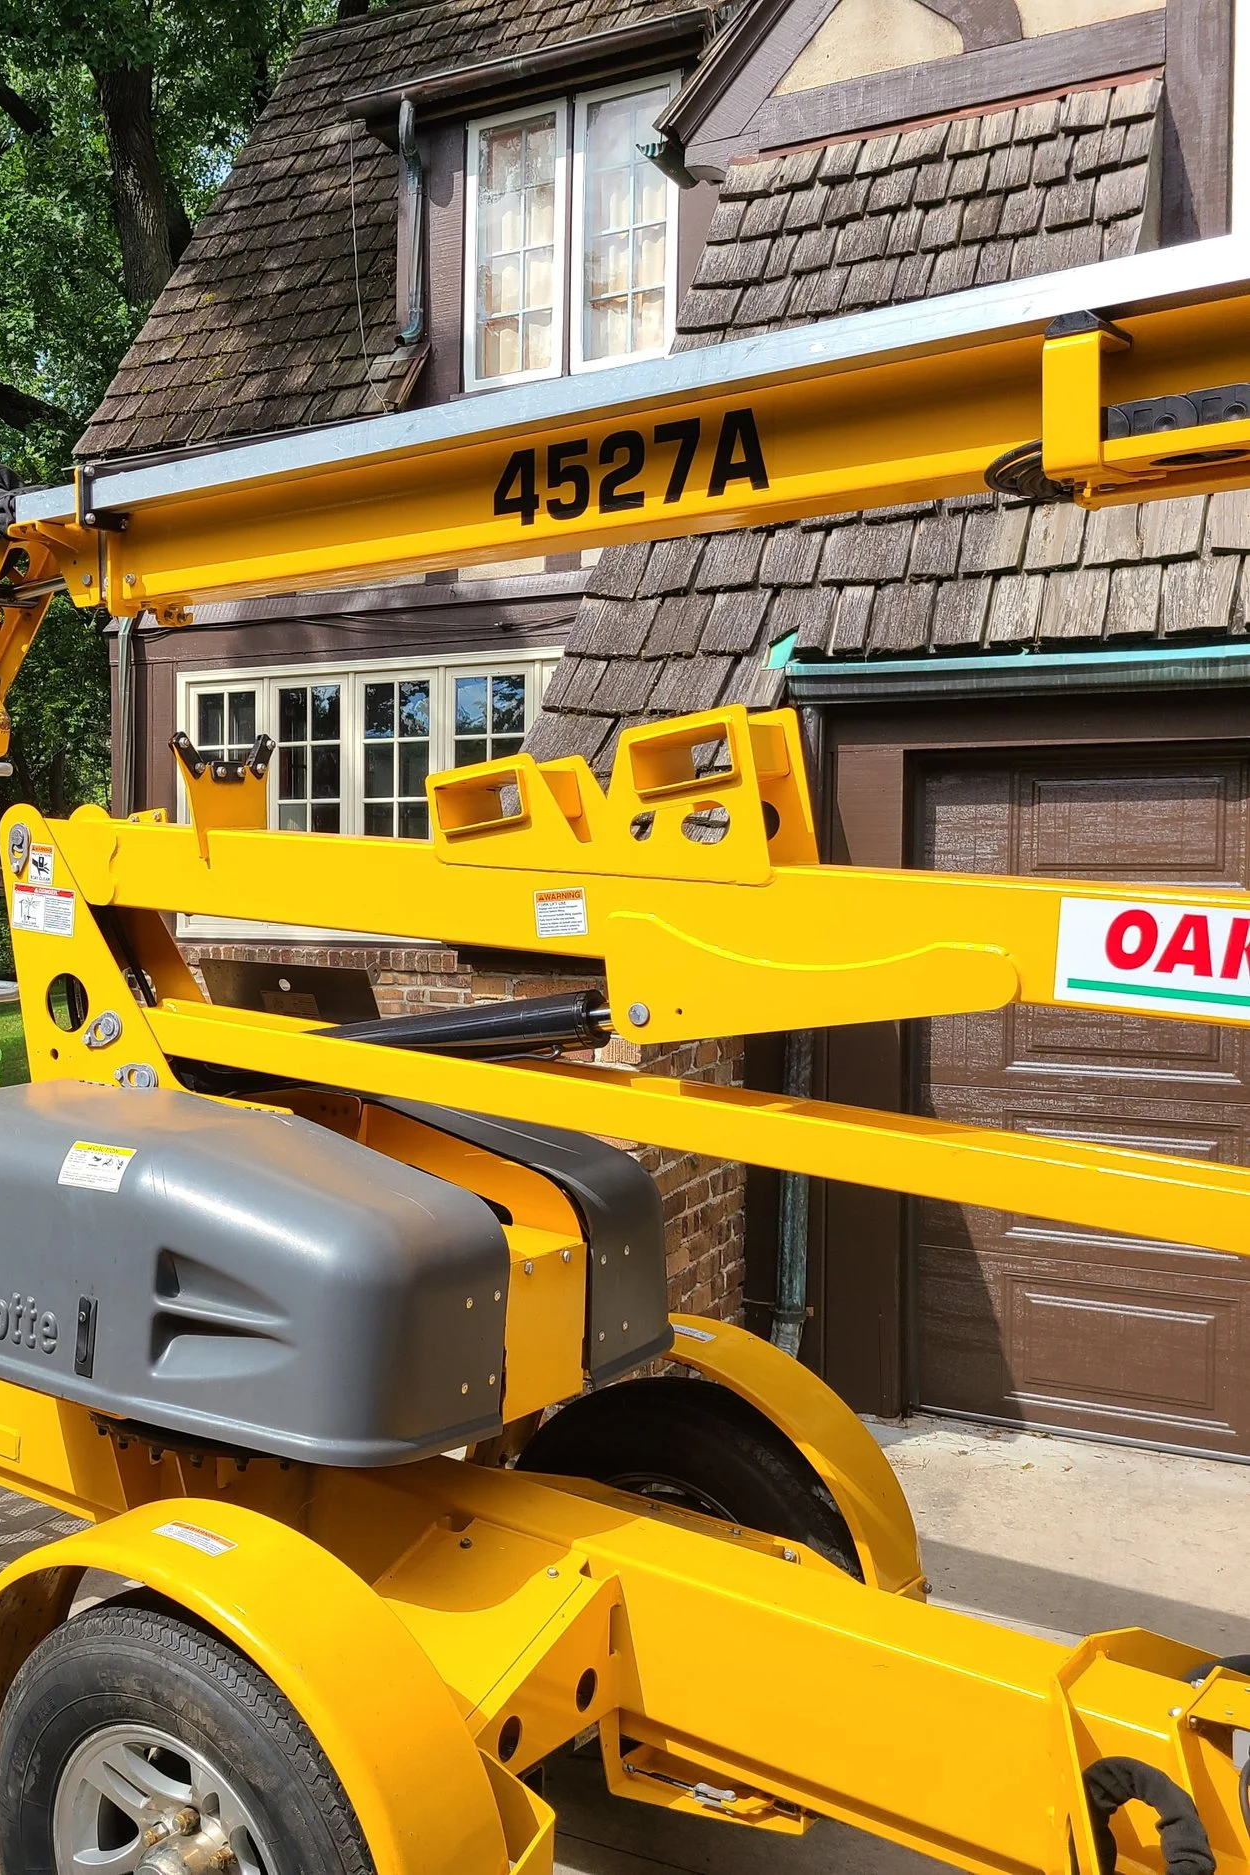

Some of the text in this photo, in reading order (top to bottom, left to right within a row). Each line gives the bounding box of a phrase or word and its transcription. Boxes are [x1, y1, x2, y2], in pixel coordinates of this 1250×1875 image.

[493, 407, 770, 526] 4527A
[544, 891, 581, 901] WARNING
[93, 1145, 119, 1154] CAUTION
